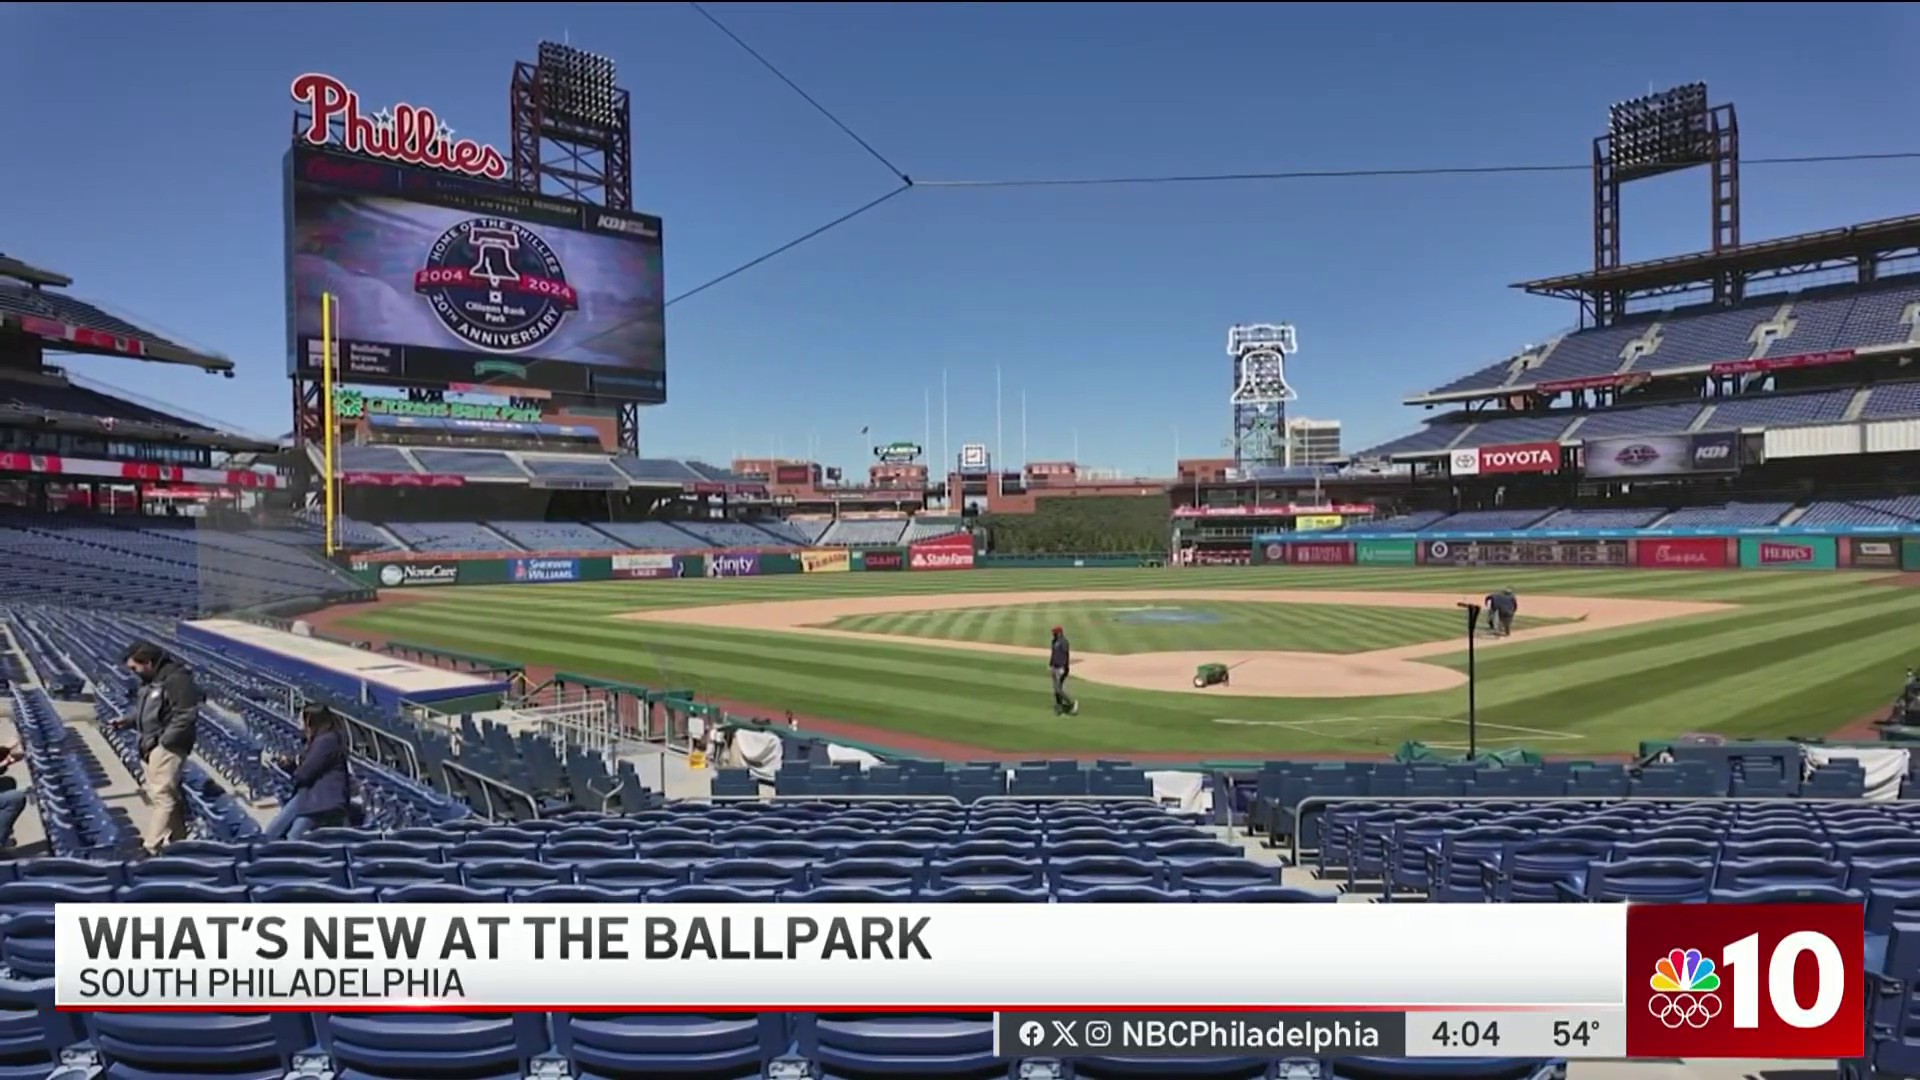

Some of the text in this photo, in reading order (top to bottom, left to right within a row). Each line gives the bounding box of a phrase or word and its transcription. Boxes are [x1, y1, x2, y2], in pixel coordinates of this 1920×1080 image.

[290, 72, 507, 180] Phillies
[431, 219, 560, 274] HOME OF THE PHILLIES
[419, 270, 464, 282] 2004
[528, 278, 571, 298] 2024
[485, 313, 506, 323] Park
[503, 303, 526, 316] Bank
[432, 293, 560, 346] 20TH ANNIVERSARY
[1482, 449, 1553, 467] TOYOTA
[403, 565, 458, 578] NovaCare
[528, 560, 573, 570] SHERWIN
[712, 556, 754, 573] xfinity
